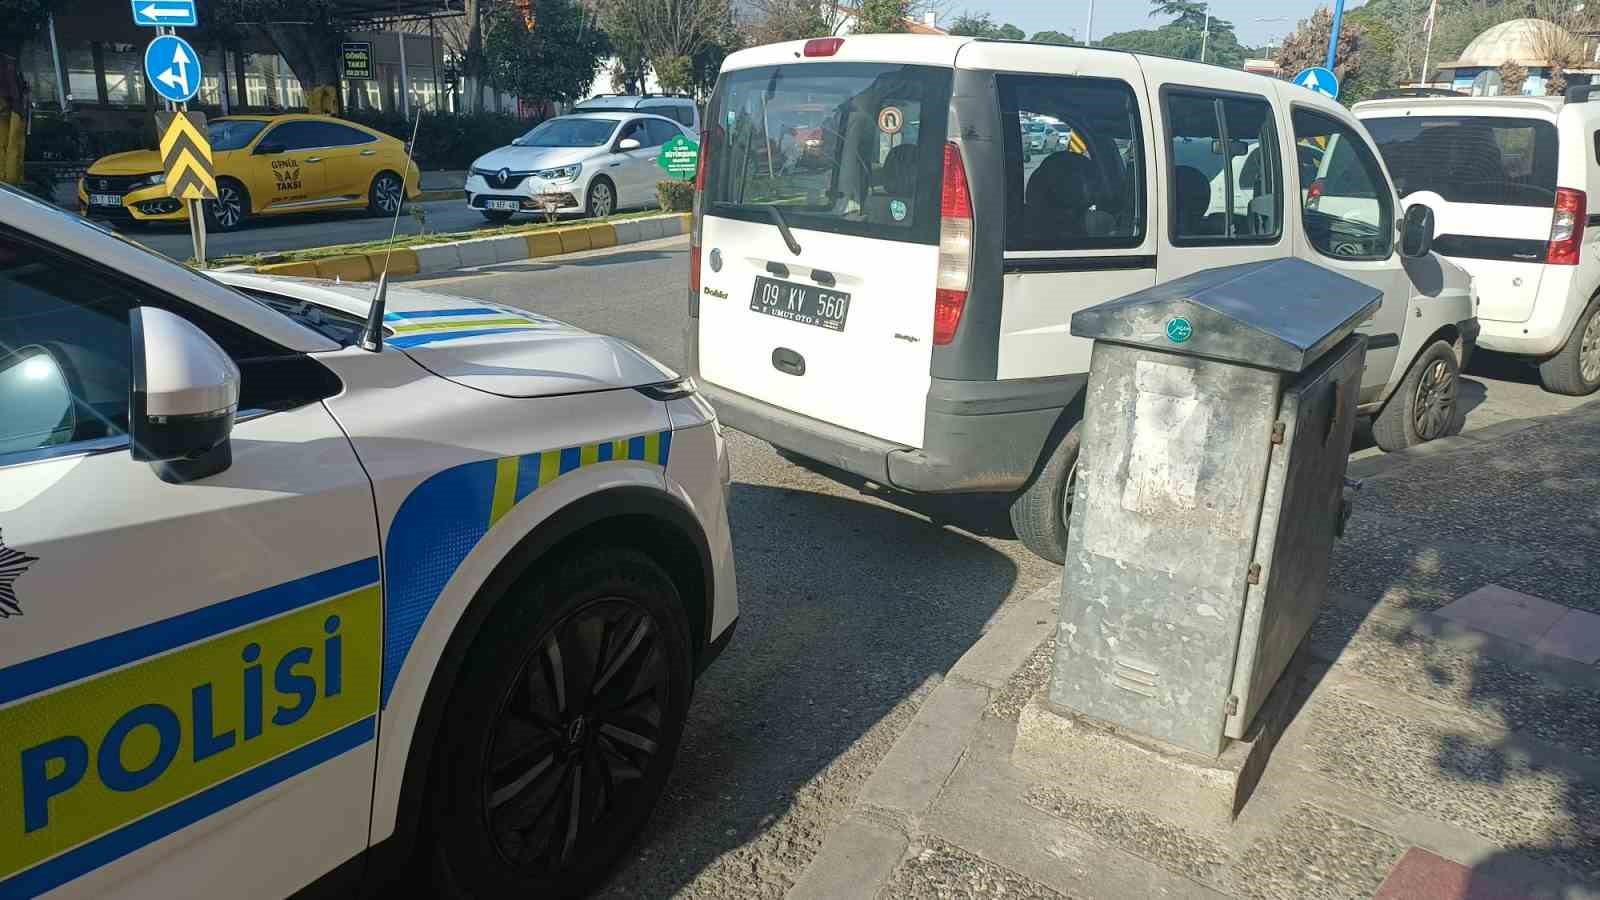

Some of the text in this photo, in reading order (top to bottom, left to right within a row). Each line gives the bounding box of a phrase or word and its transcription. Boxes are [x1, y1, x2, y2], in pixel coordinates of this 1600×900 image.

[762, 283, 844, 320] 09 KV 560
[795, 314, 813, 324] OTO
[21, 615, 342, 834] POLİSİ
